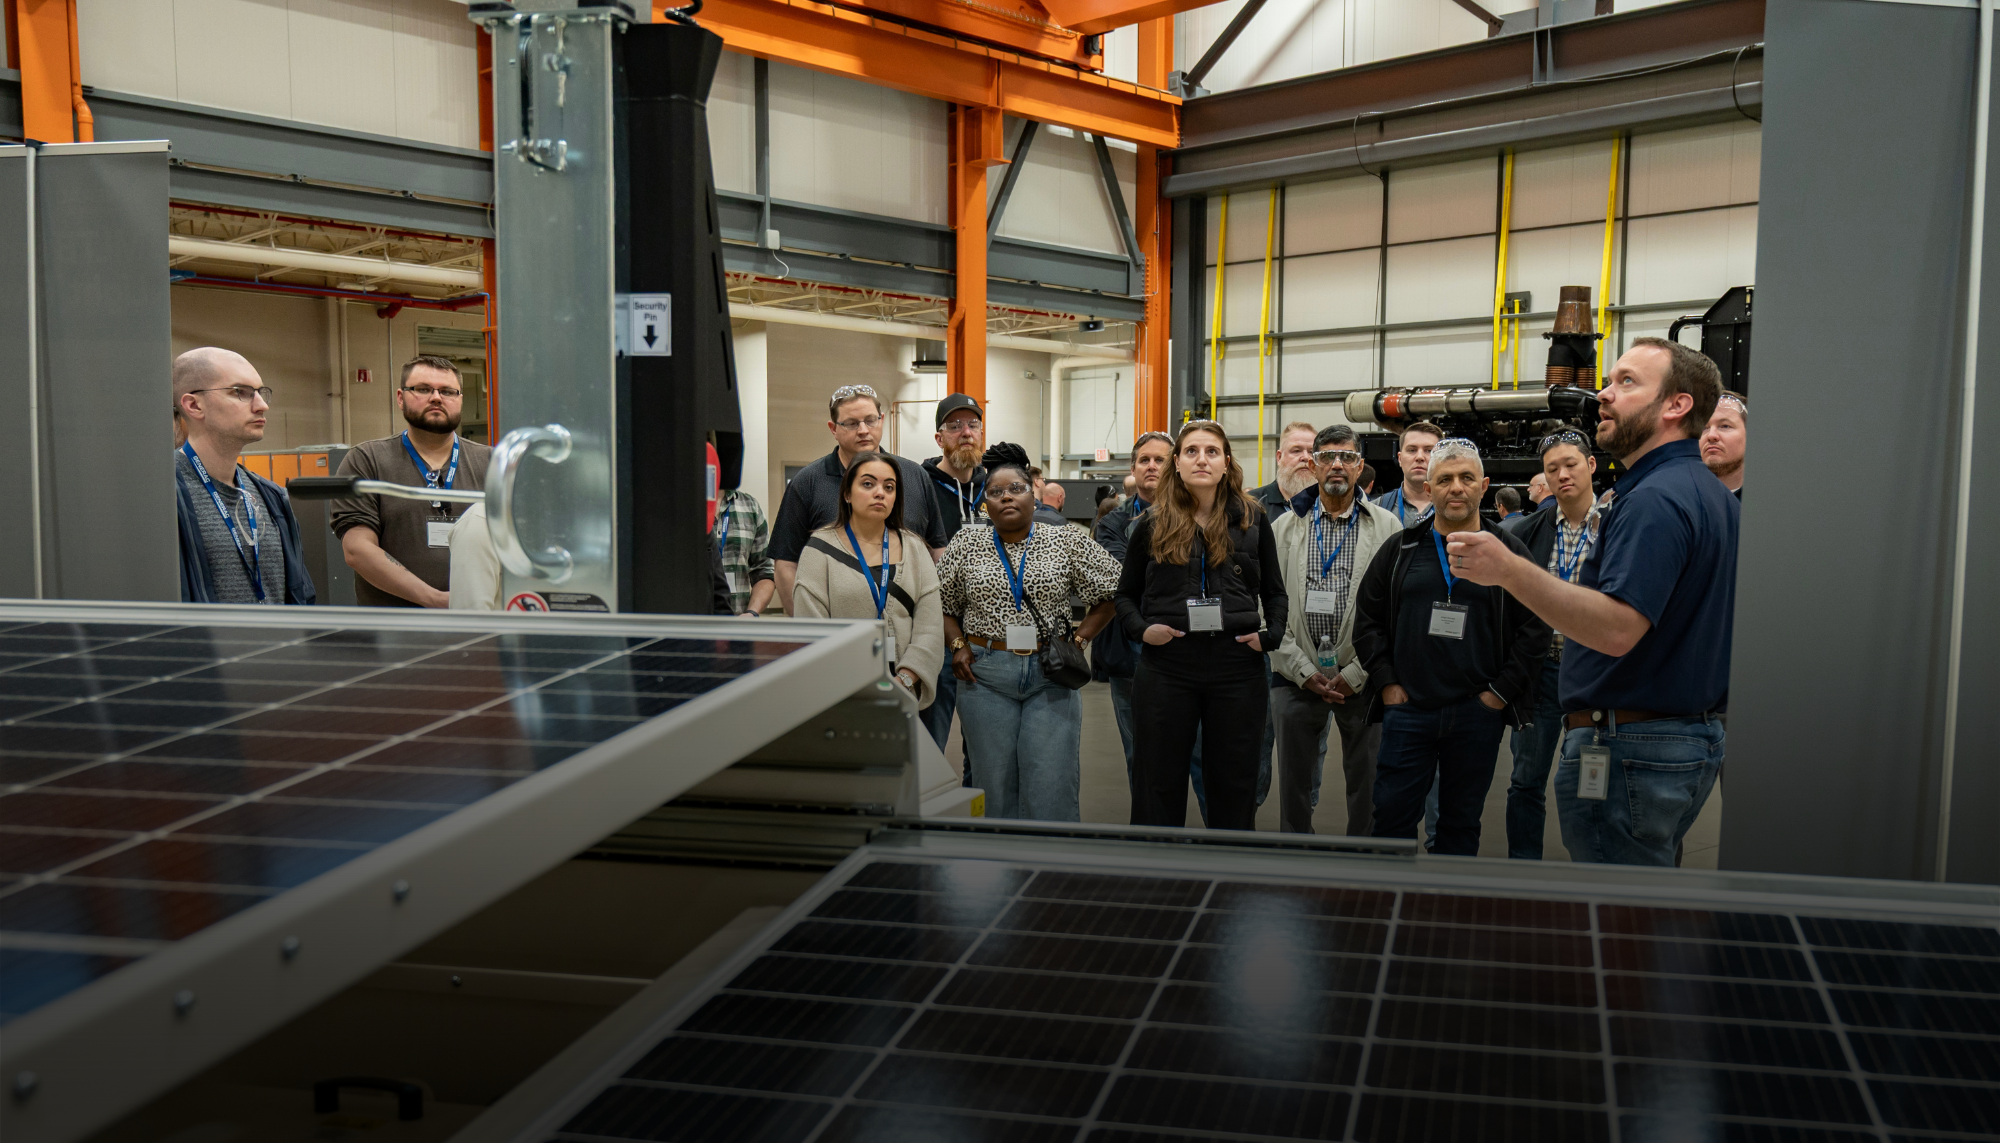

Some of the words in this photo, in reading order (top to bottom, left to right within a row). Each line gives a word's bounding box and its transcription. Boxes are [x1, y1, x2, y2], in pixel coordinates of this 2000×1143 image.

[634, 302, 667, 312] Security
[644, 313, 657, 321] Pin
[193, 455, 210, 483] GENERAC
[213, 491, 230, 518] GENERAC
